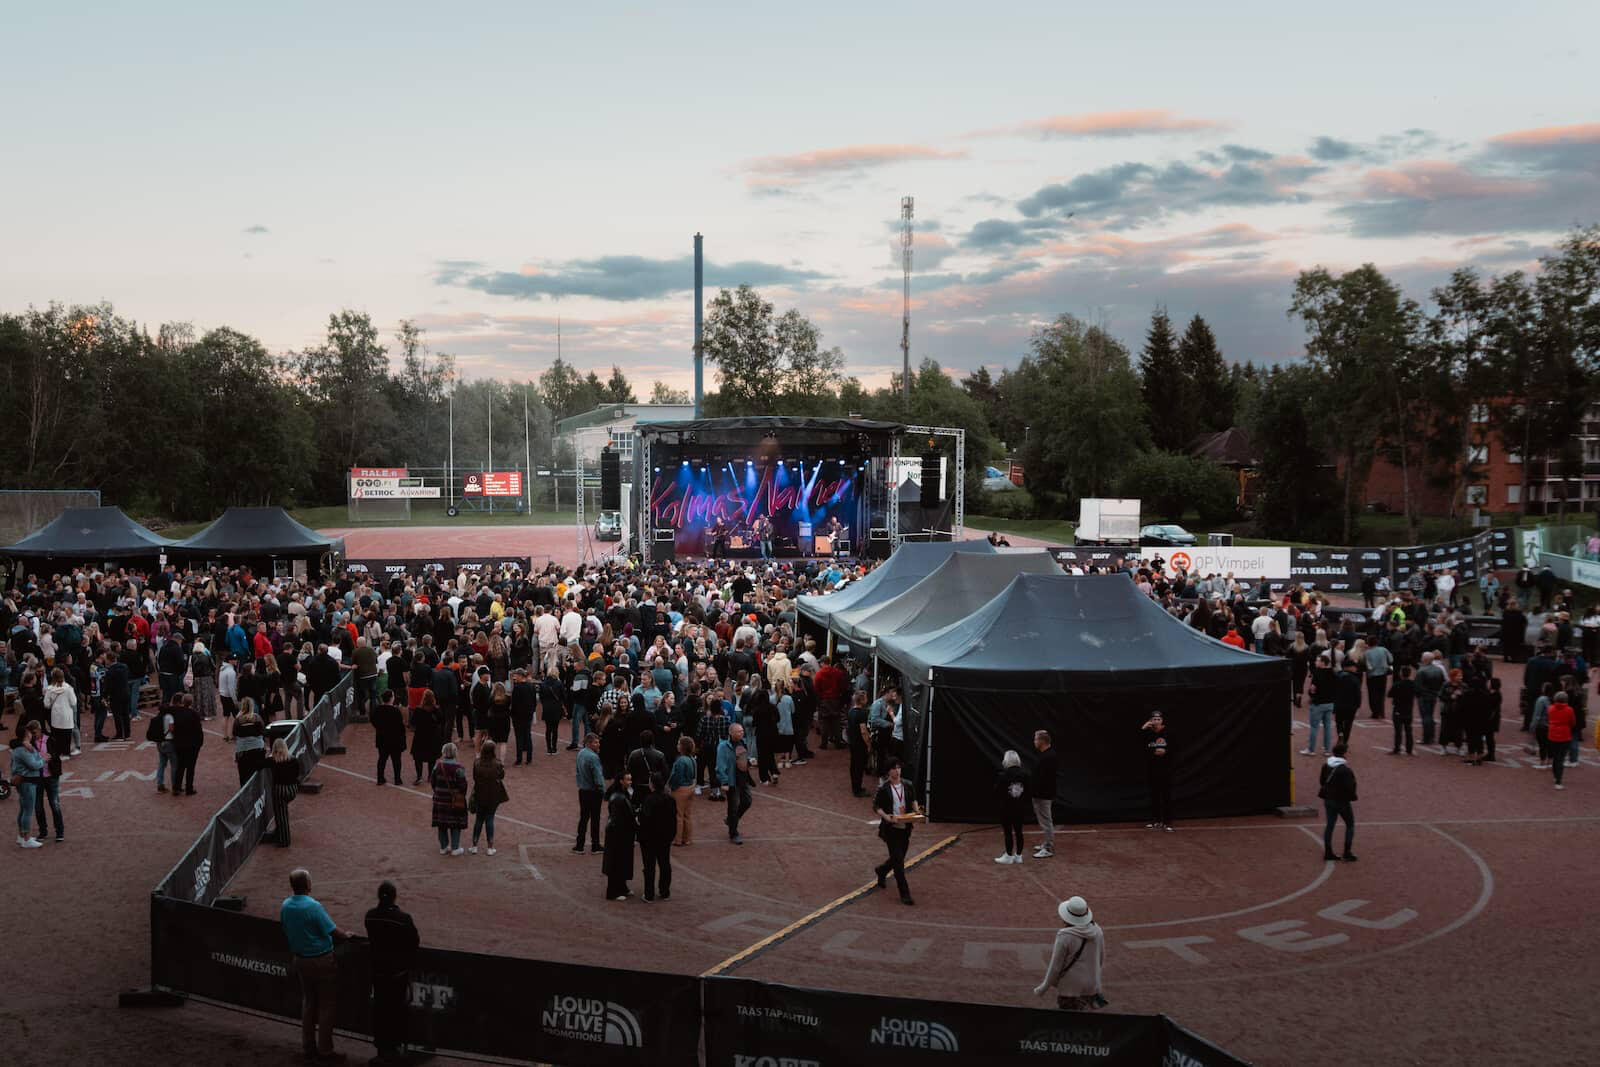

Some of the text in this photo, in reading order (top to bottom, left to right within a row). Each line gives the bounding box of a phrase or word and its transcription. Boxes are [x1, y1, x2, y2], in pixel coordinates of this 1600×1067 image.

[650, 474, 747, 528] Kolmas
[1195, 555, 1265, 572] OP Vimpeli
[553, 994, 604, 1016] LOUD
[736, 1004, 819, 1026] TAAS TAPAHTUU
[544, 1027, 603, 1042] PROMOTIONS
[880, 1016, 929, 1035] LOUD
[1018, 1039, 1110, 1057] TAAS TAPAHTUU
